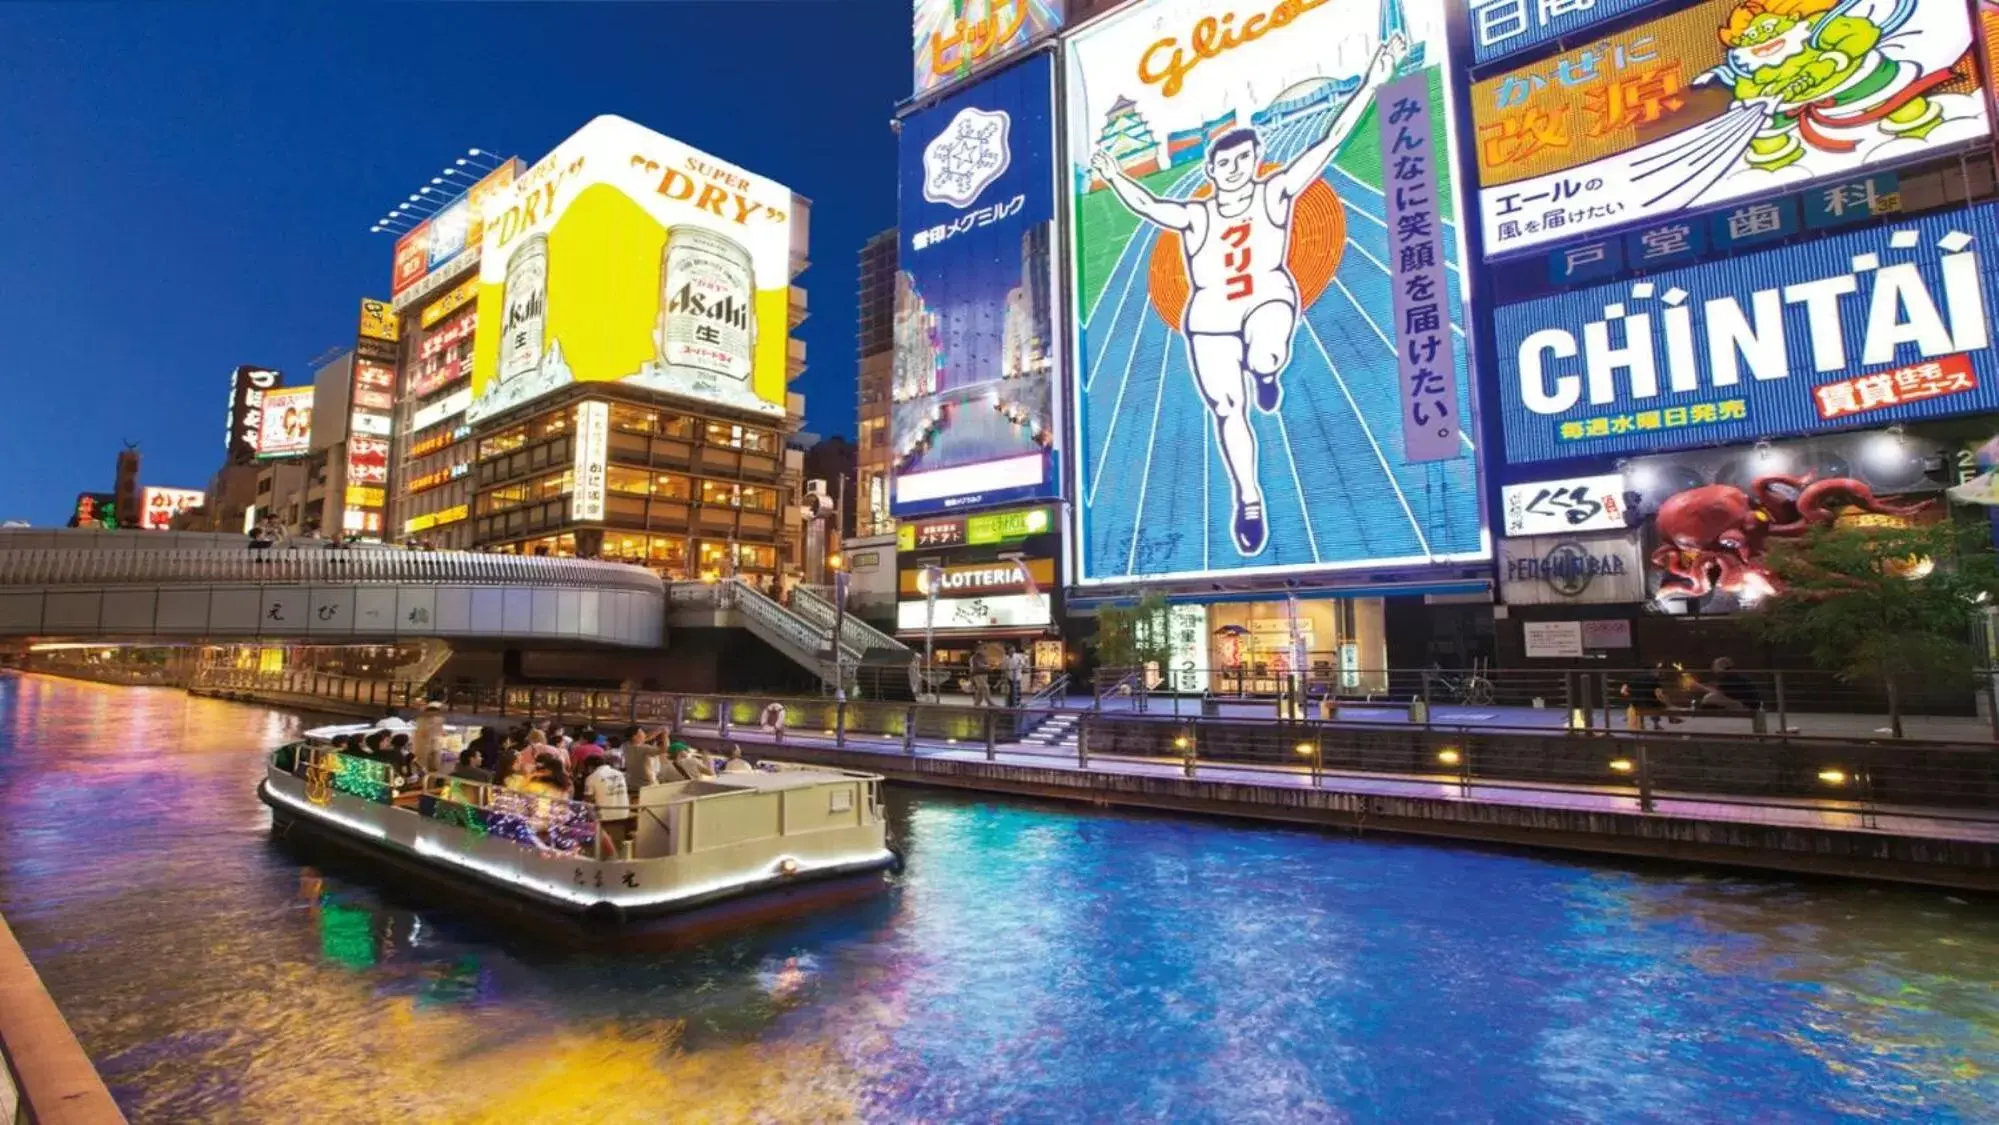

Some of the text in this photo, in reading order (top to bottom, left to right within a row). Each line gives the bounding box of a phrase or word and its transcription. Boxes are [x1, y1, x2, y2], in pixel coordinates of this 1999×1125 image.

[1138, 0, 1330, 97] Glico
[1494, 36, 1658, 109] かぜに
[1479, 60, 1685, 168] 改源
[685, 157, 750, 192] SUPER
[1496, 177, 1604, 216] エールの
[1498, 202, 1625, 242] 風を届けたい
[1220, 217, 1253, 300] グリコ
[1388, 97, 1449, 438] みんなに笑顔を届けたい。
[668, 281, 747, 331] Asahi
[695, 325, 720, 345] 生
[1560, 400, 1747, 439] 毎週水曜日発売
[1525, 486, 1602, 525] くくる
[941, 568, 1026, 588] LOTTERIA
